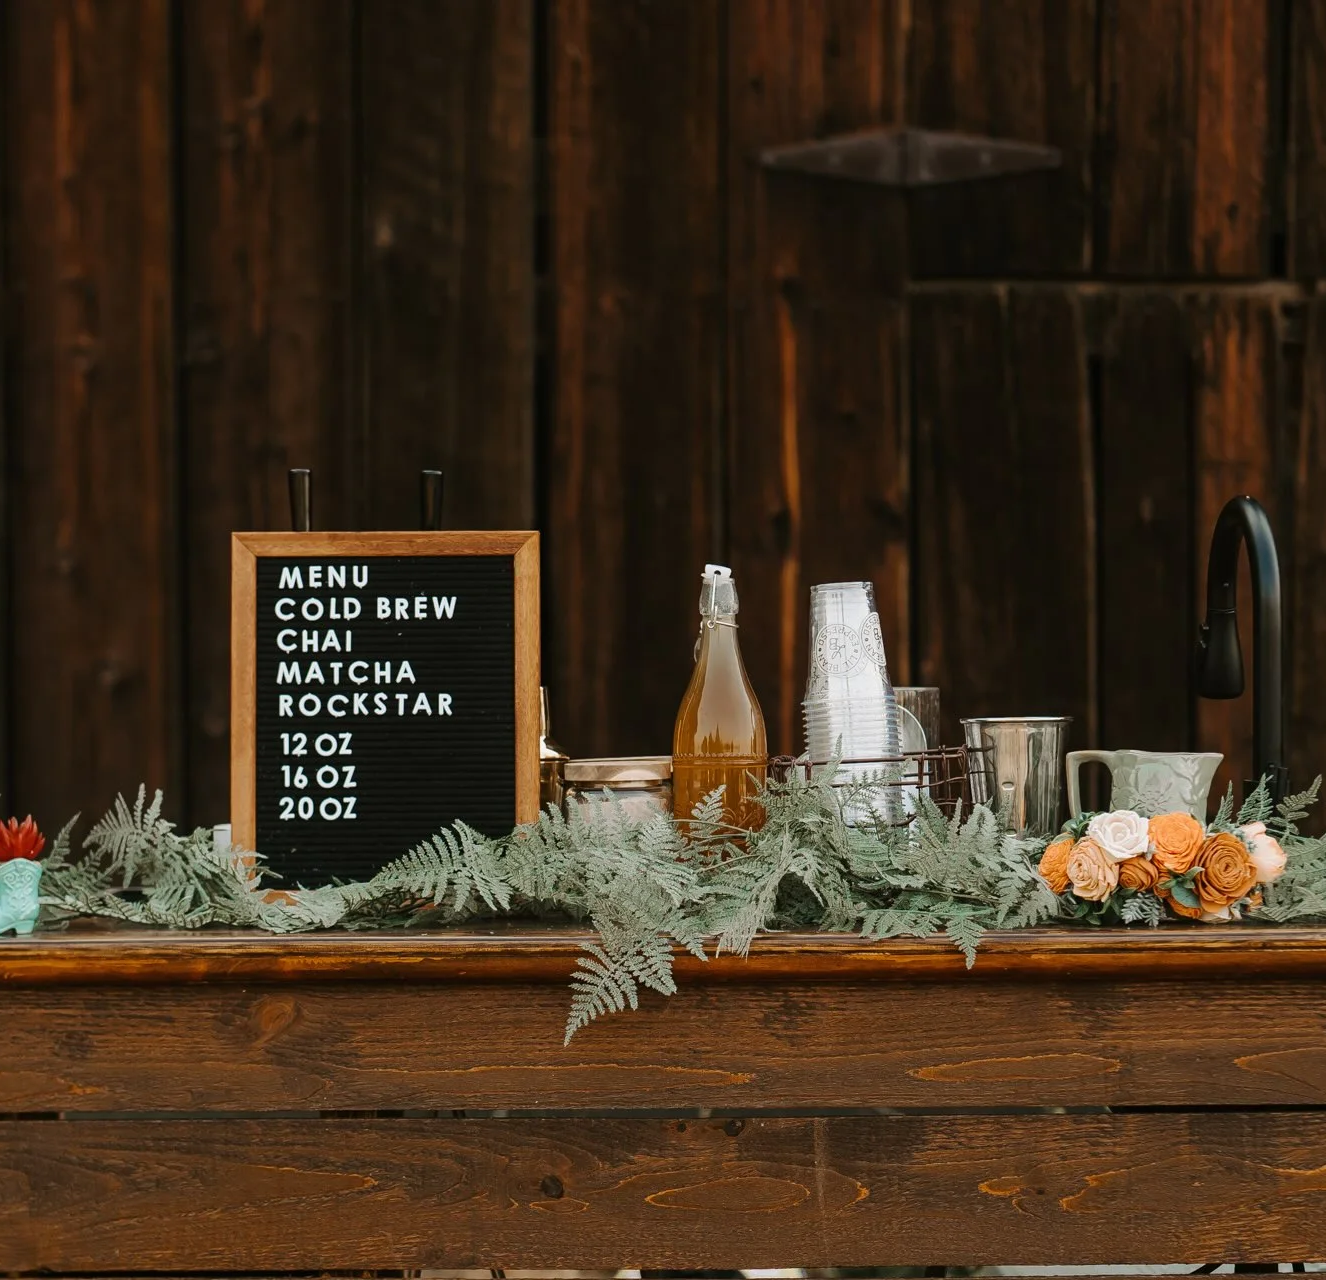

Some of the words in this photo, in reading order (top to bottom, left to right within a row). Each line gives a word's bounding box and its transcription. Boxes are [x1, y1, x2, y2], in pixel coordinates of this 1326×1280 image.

[279, 566, 368, 588] MENU
[275, 598, 361, 621] COLD
[377, 597, 456, 620] BREW
[277, 629, 351, 653] CHAI
[817, 626, 859, 647] ESPRESSO
[277, 661, 415, 685] MATCHA
[279, 693, 452, 717] ROCKSTAR
[281, 733, 307, 756] 12
[315, 732, 352, 756] OZ
[281, 765, 308, 789] 16
[317, 765, 356, 788] OZ
[280, 797, 313, 820] 20
[320, 797, 356, 820] OZ
